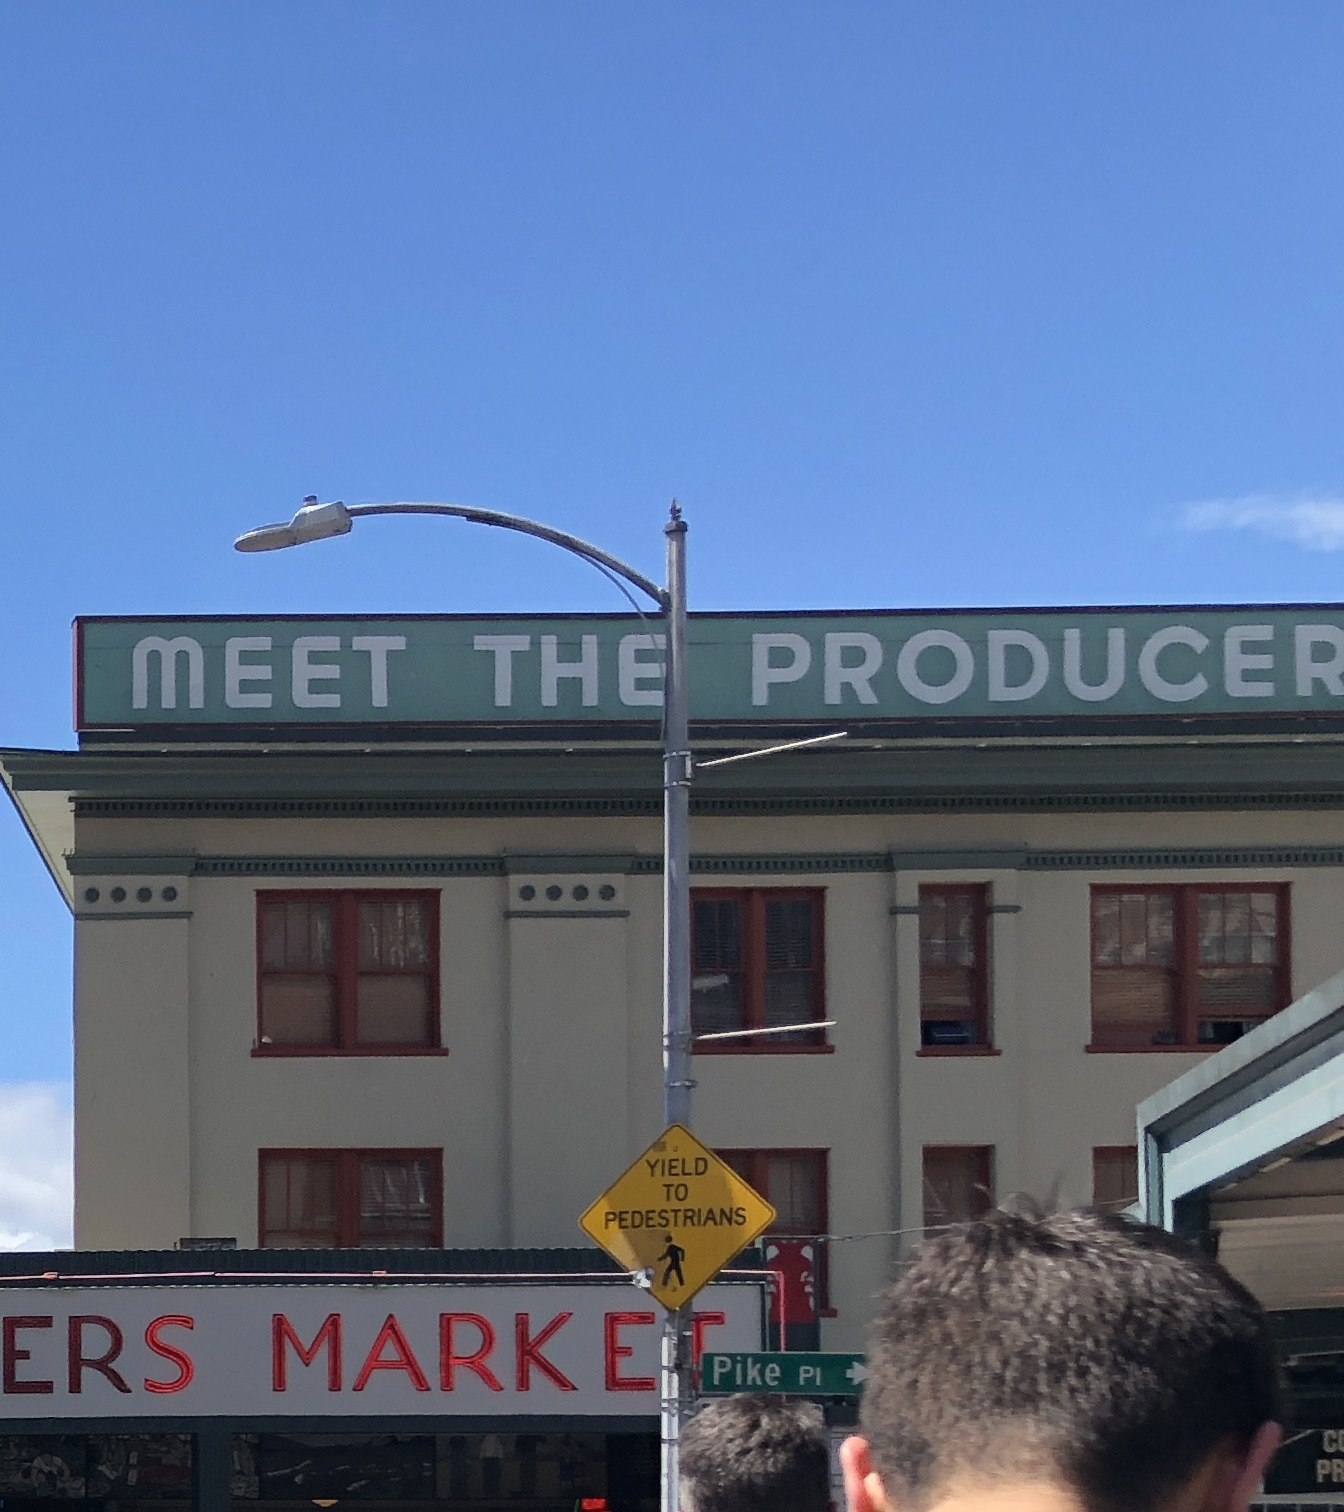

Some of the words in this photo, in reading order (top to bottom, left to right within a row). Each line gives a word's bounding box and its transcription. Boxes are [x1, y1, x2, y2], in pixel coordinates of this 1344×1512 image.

[131, 634, 407, 709] MEET
[473, 634, 666, 707] THE
[751, 624, 1344, 706] PRODUCER
[645, 1157, 708, 1178] YIELD
[662, 1183, 689, 1202] TO
[603, 1206, 747, 1231] PEDESTRIANS
[712, 1355, 782, 1388] Pike
